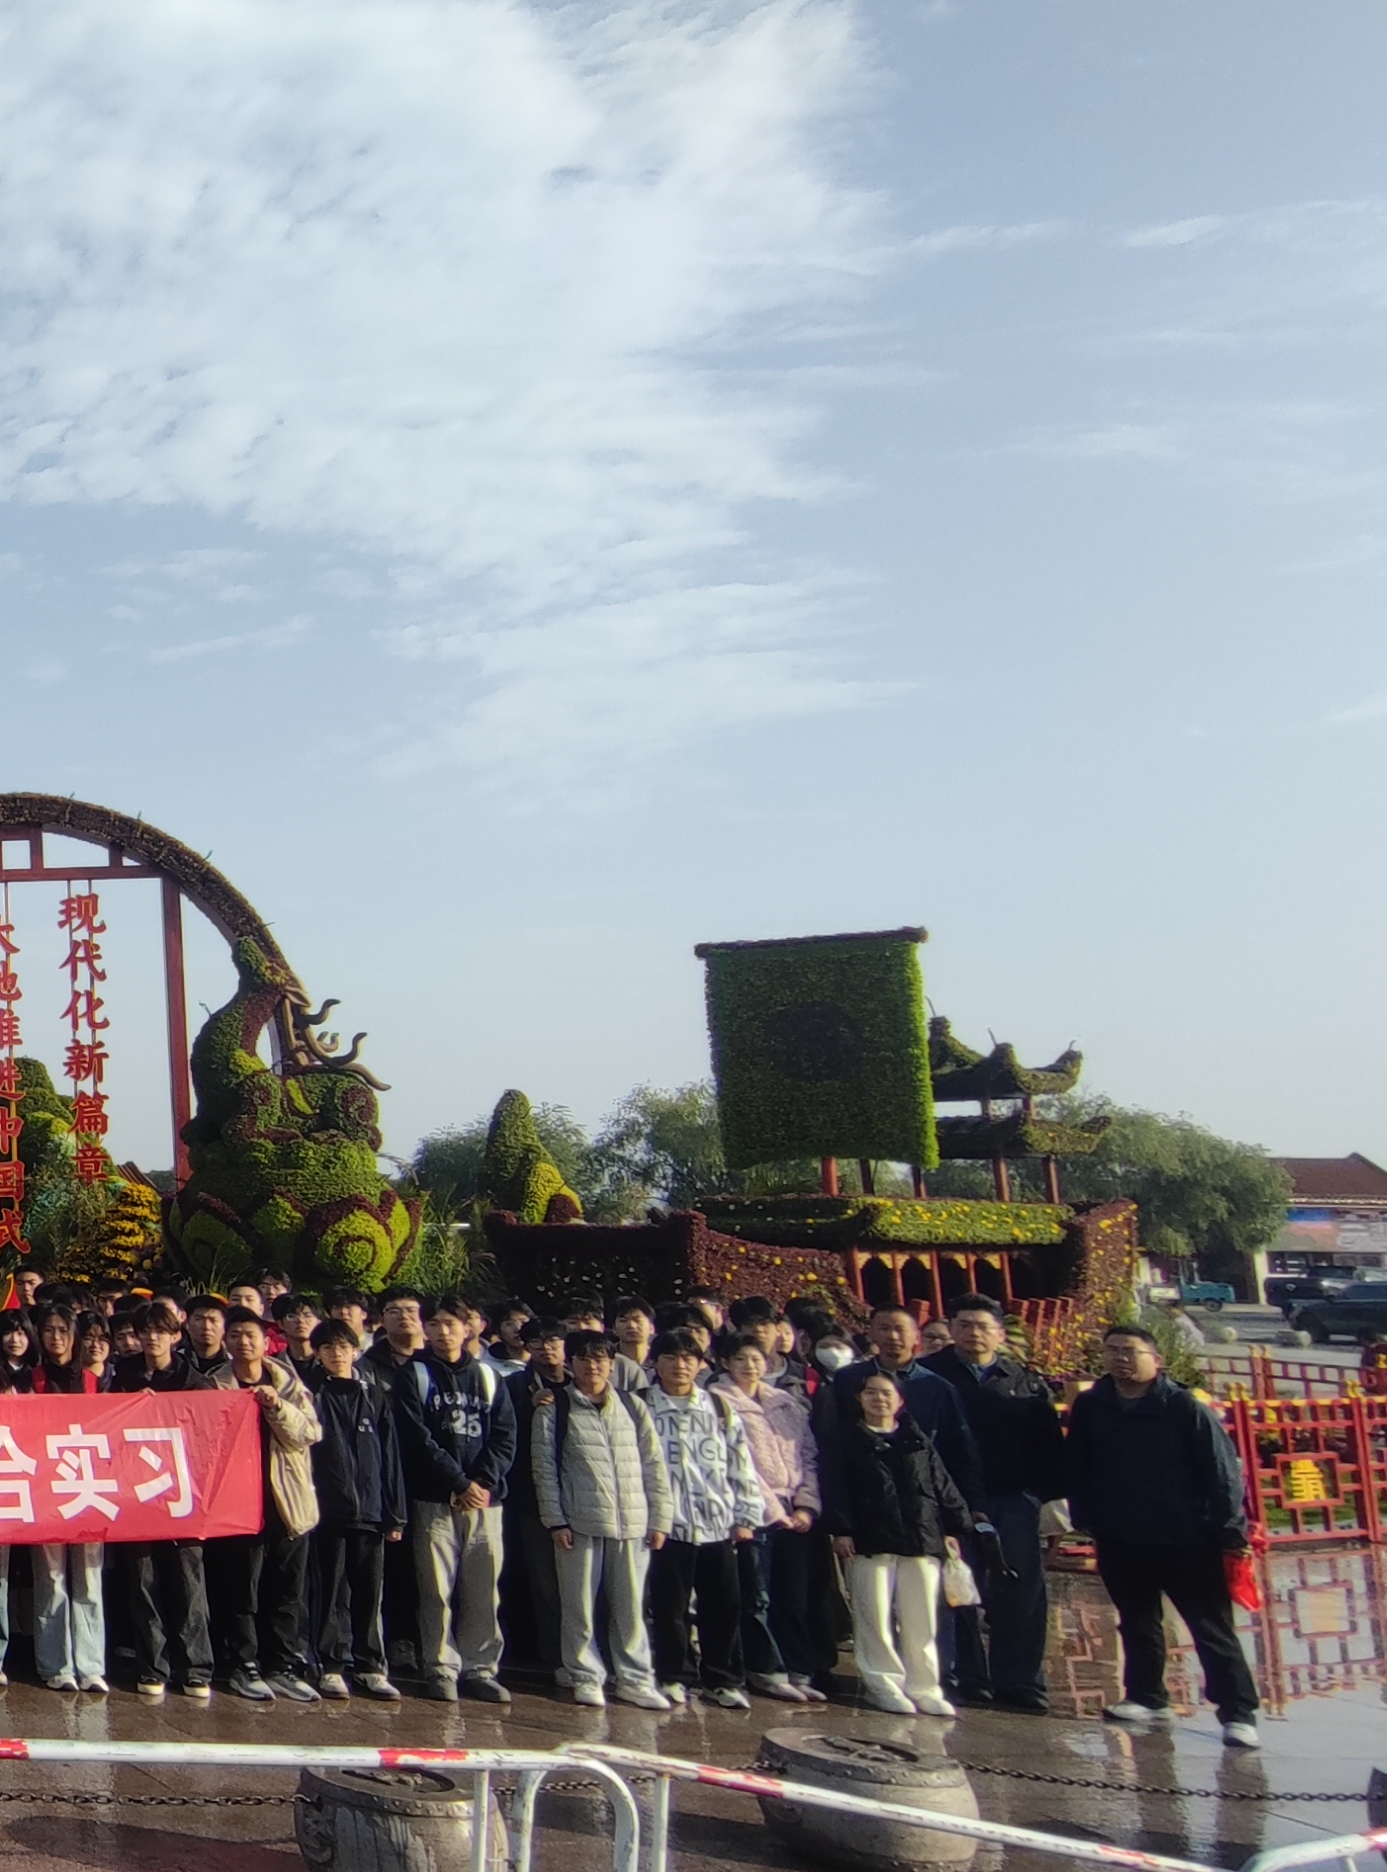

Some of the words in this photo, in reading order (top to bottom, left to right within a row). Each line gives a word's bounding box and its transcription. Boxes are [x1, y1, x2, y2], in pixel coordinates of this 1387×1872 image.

[57, 893, 110, 1186] 现代化新篇章
